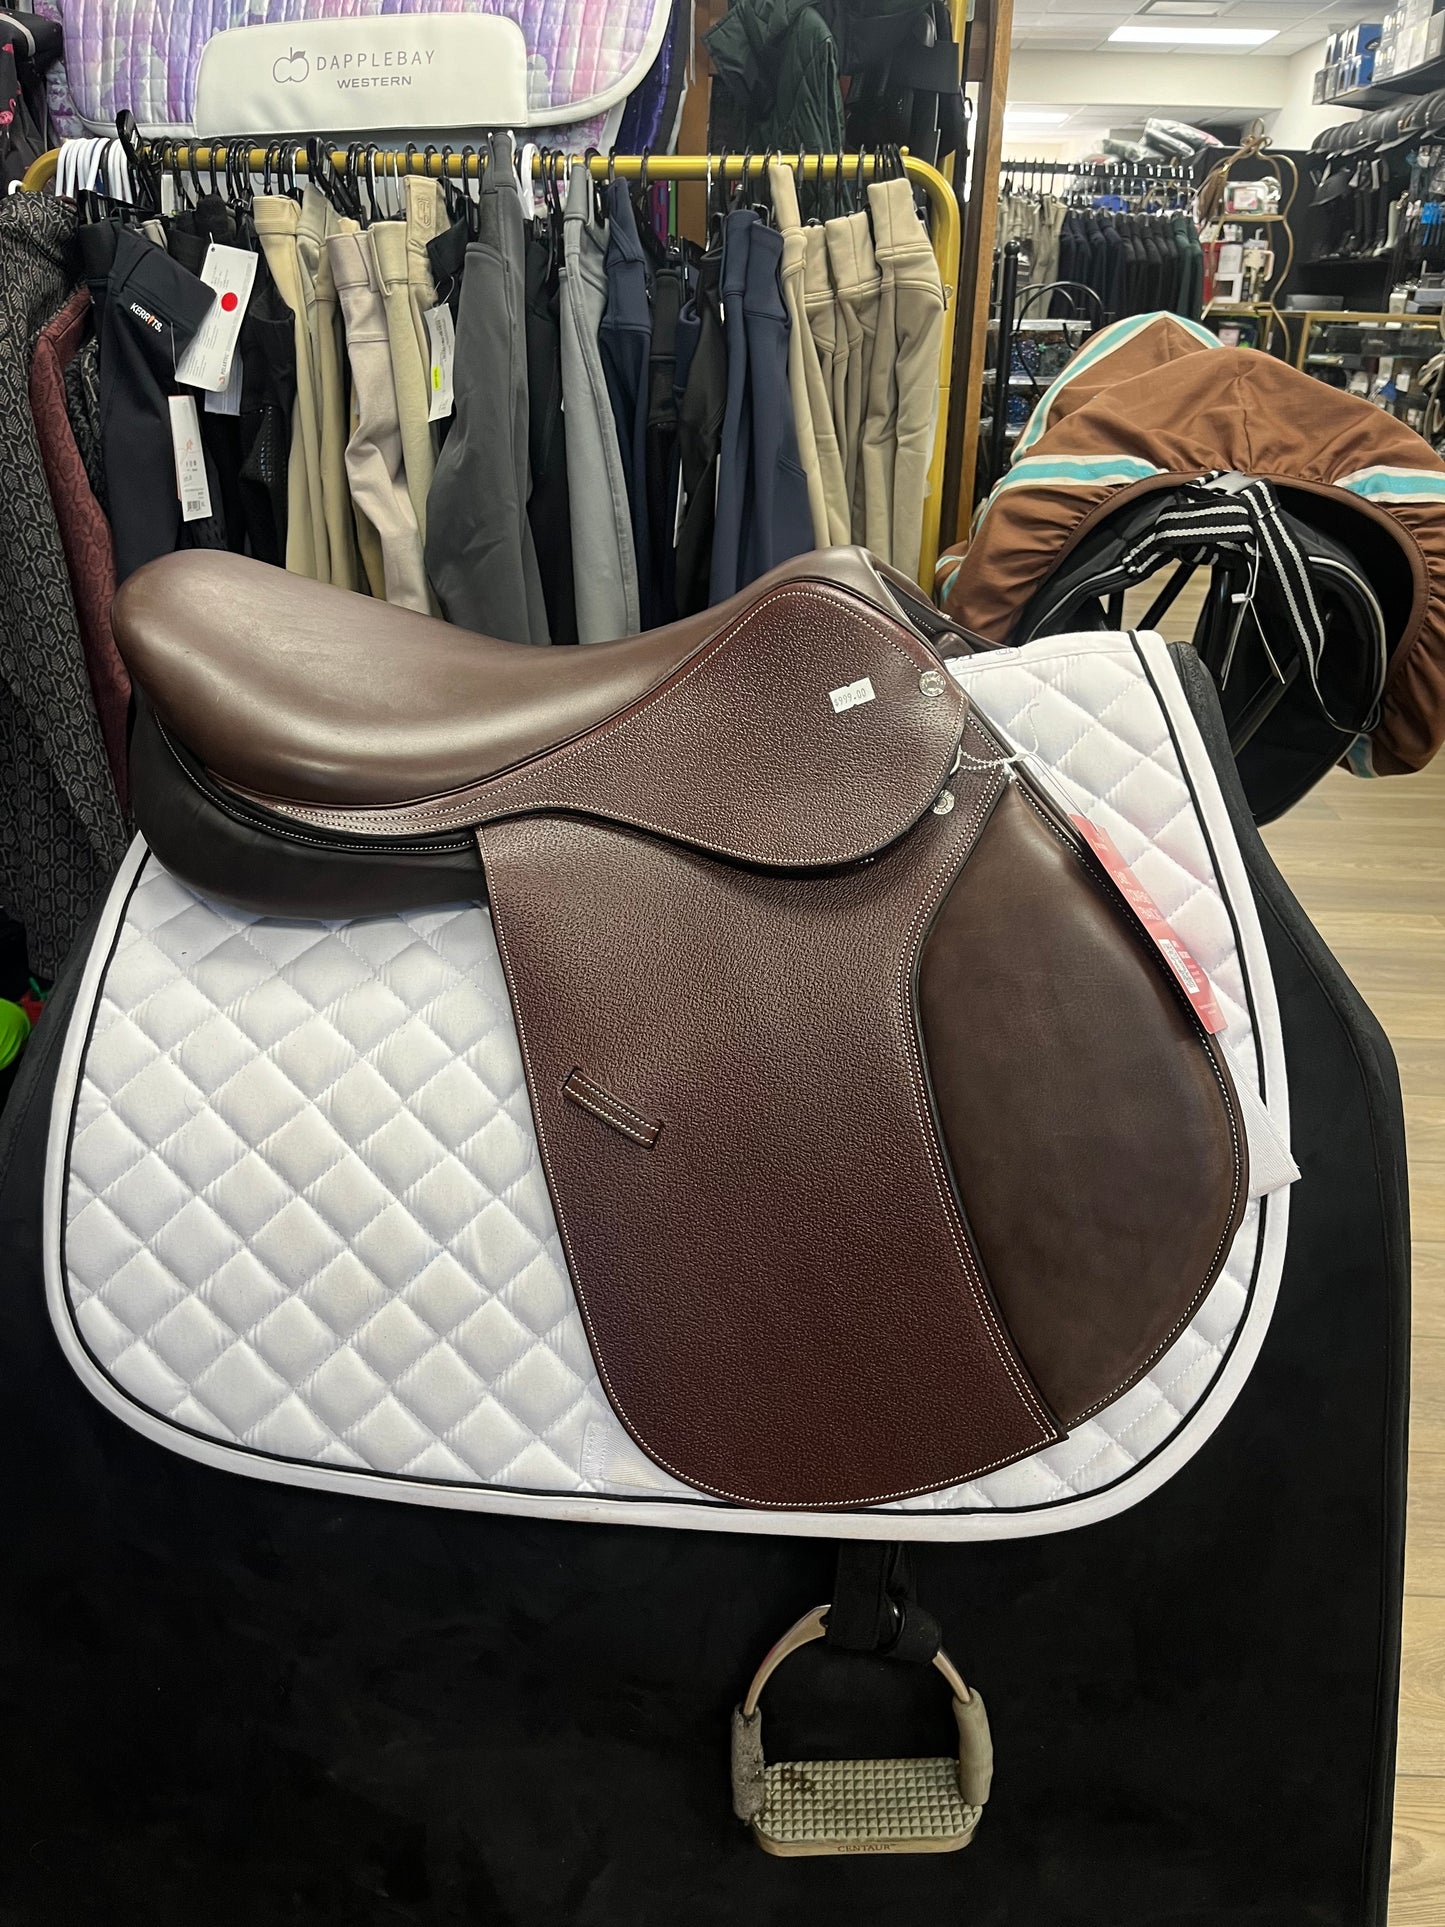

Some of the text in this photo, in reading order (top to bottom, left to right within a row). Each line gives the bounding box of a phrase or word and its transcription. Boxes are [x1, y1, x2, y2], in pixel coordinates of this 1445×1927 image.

[316, 50, 435, 71] DAPPLEBAY
[337, 76, 412, 89] WESTERN
[834, 687, 867, 707] $999.00
[837, 1843, 891, 1853] CENTAUR
